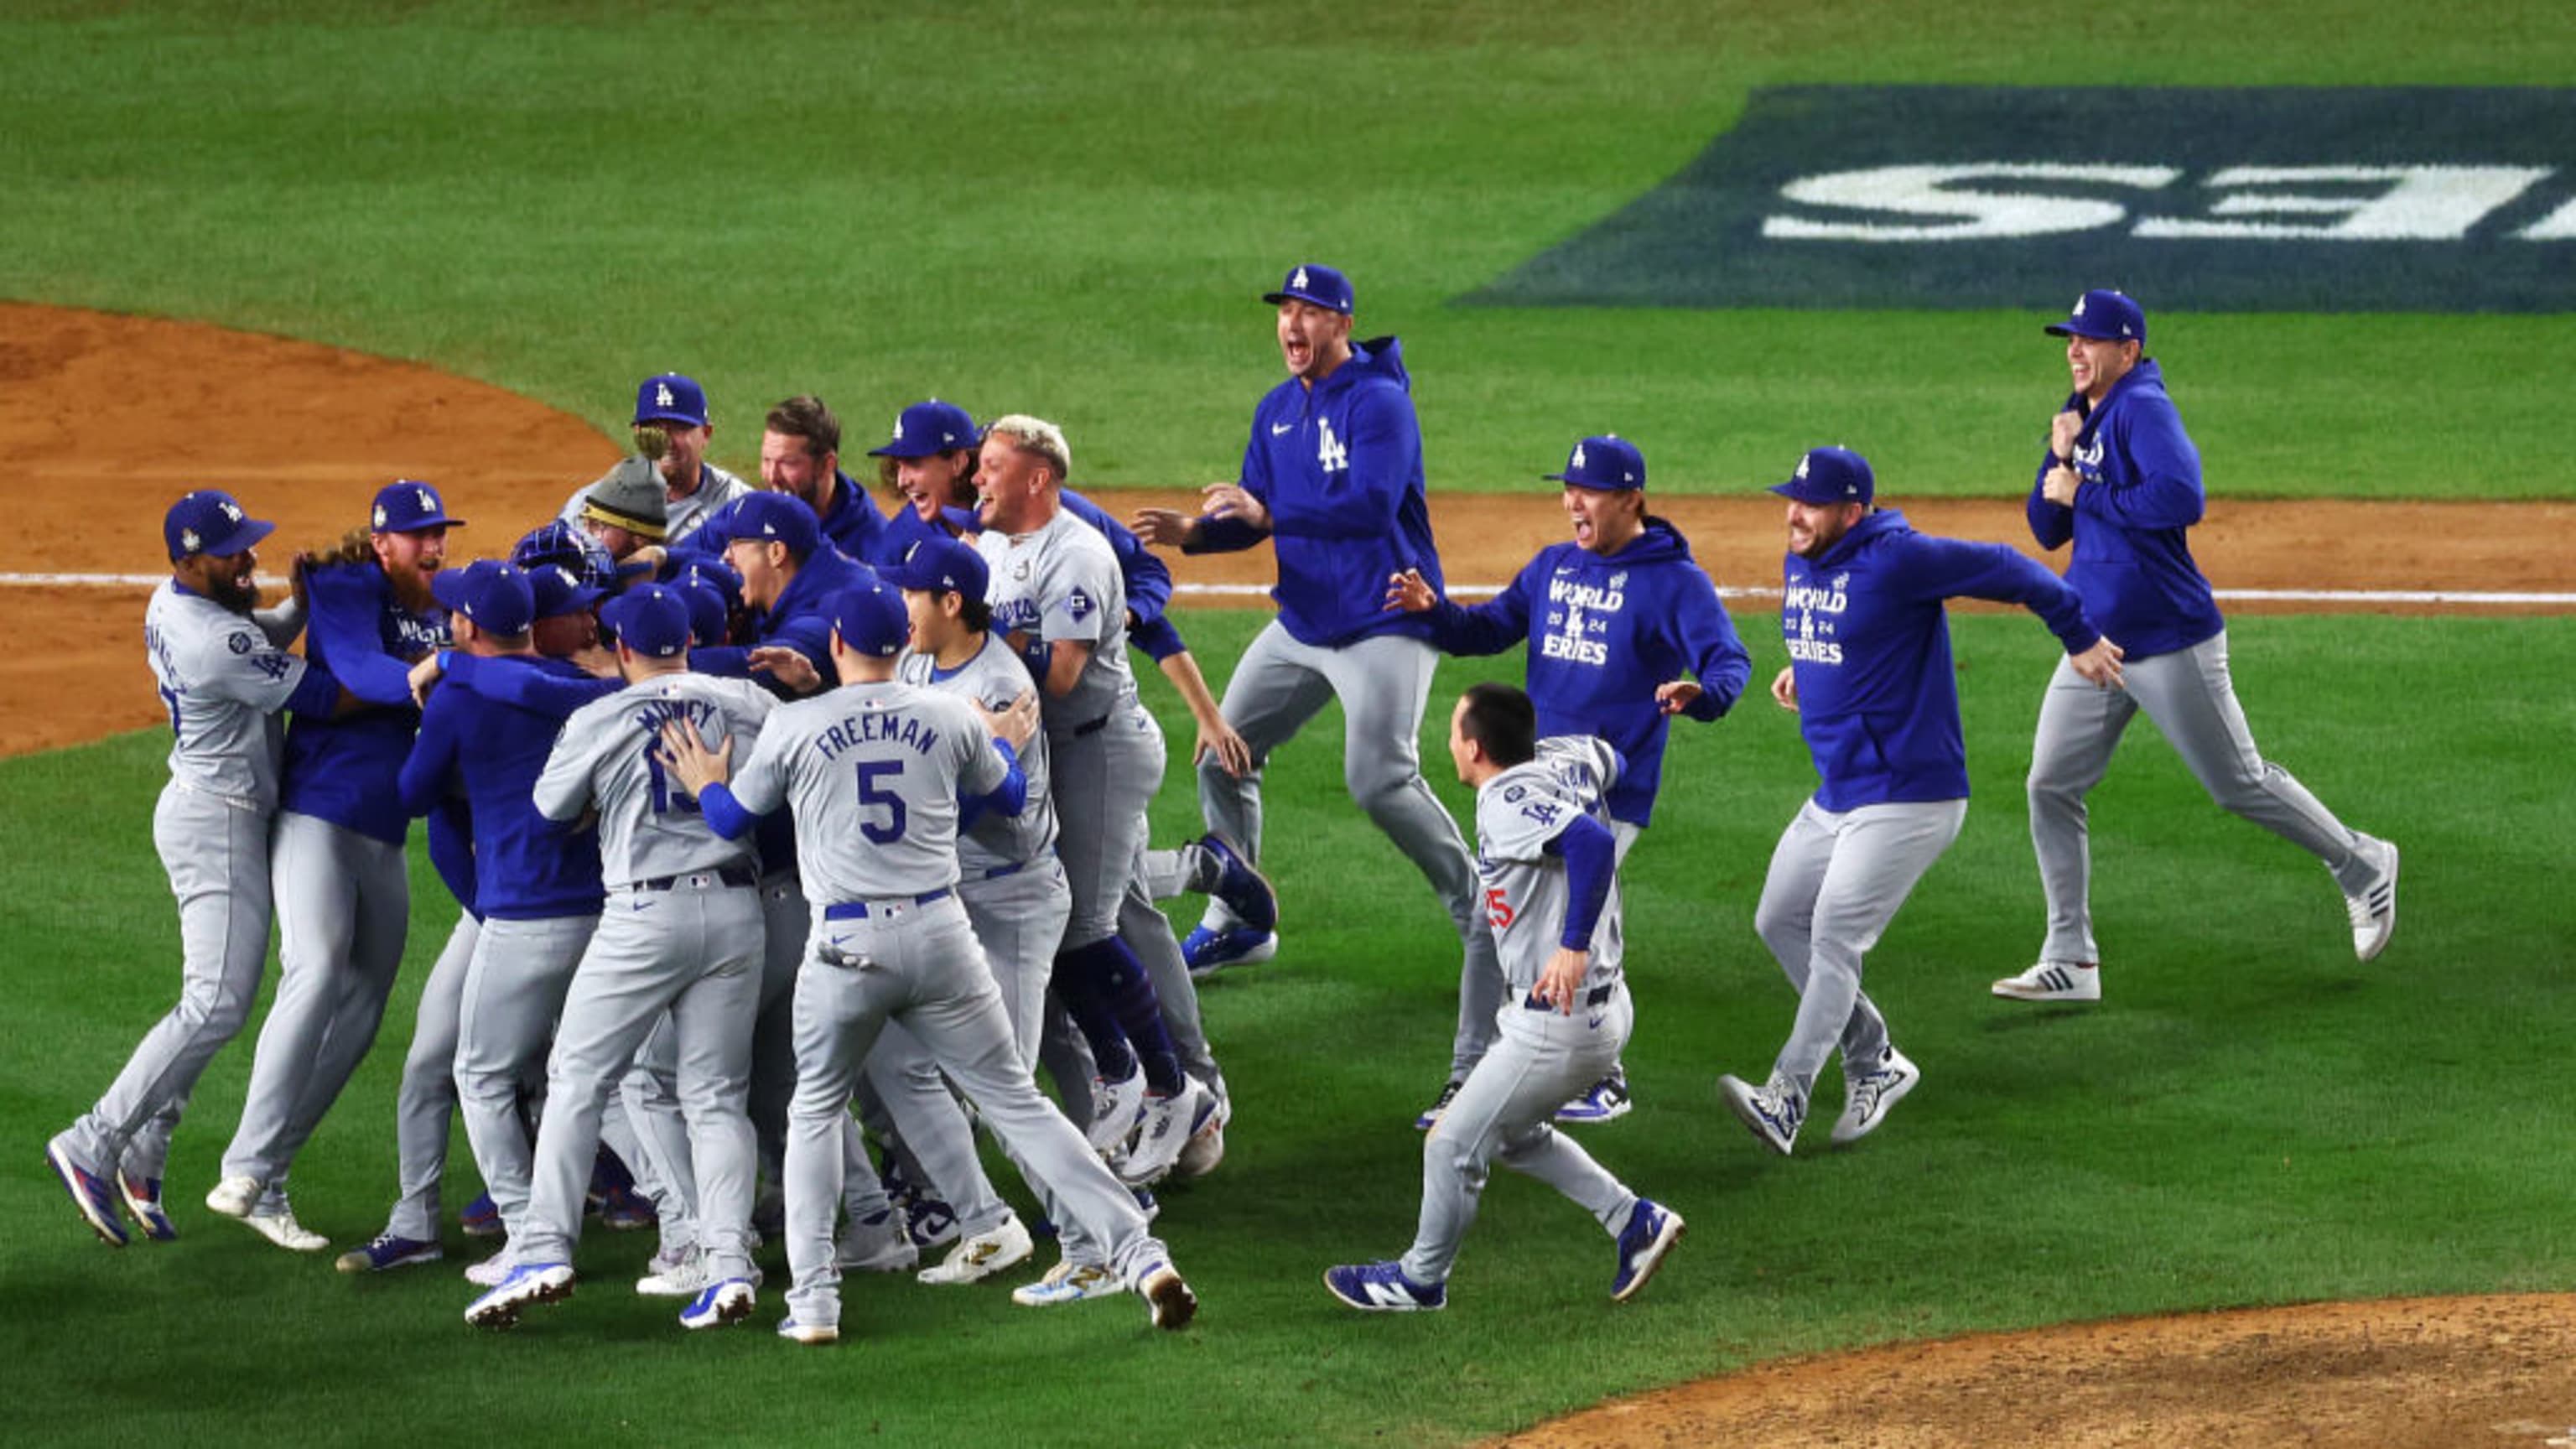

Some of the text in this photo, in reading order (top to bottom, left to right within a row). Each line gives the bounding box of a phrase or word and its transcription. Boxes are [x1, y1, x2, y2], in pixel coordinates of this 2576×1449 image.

[1317, 417, 1348, 472] LA
[1549, 578, 1624, 612] WORLD
[816, 713, 938, 761] FREEMAN
[856, 760, 906, 845] 5
[1521, 802, 1562, 826] LA
